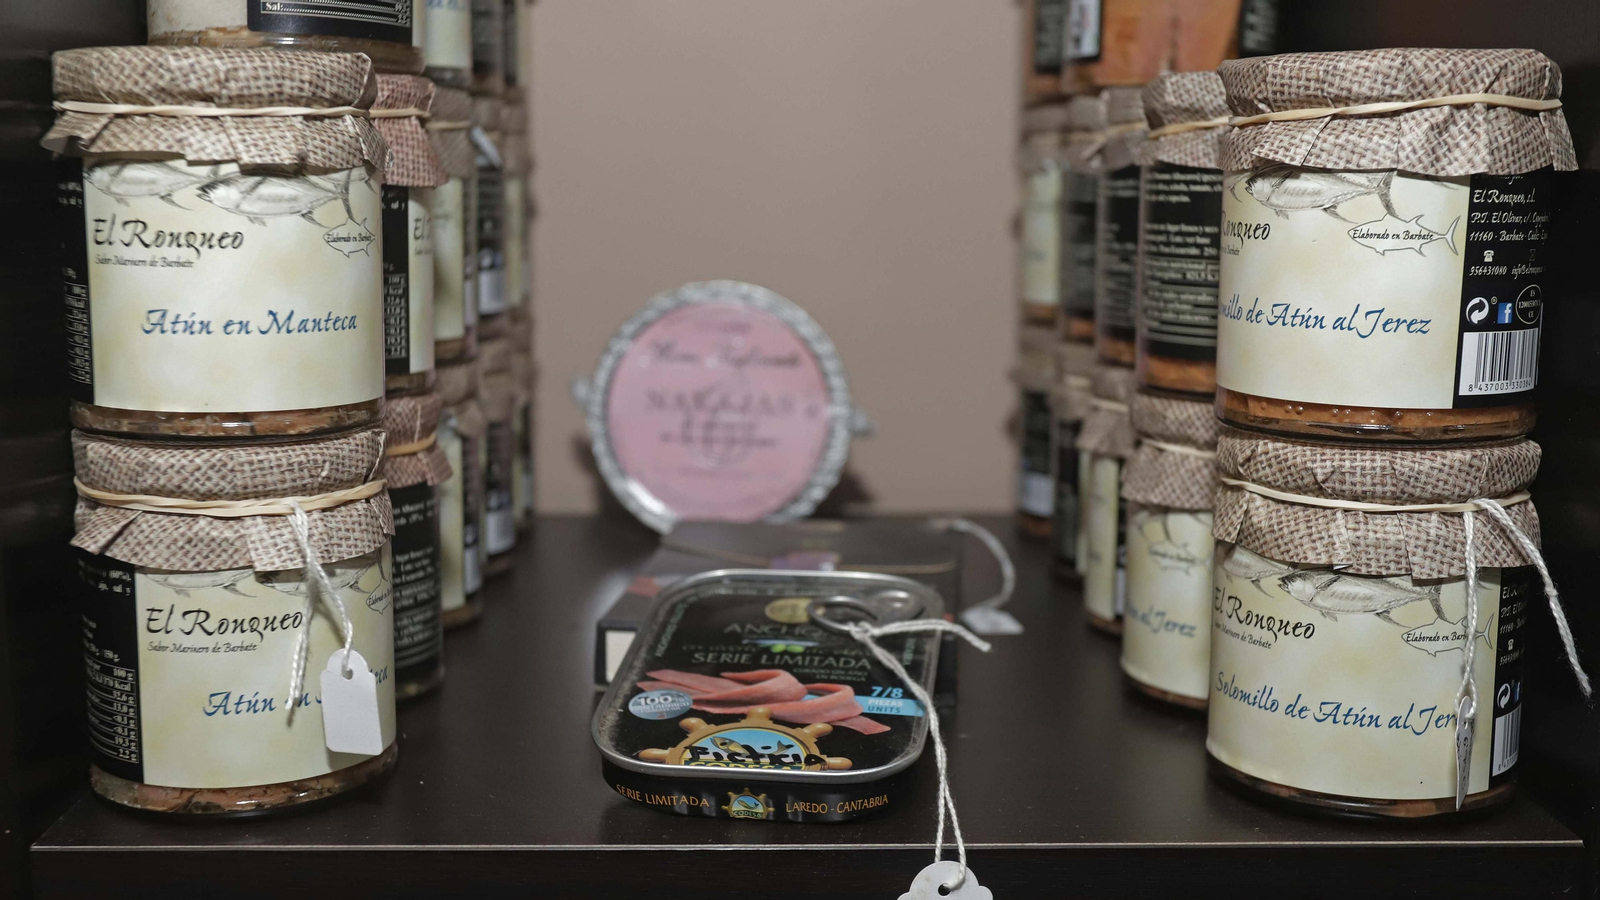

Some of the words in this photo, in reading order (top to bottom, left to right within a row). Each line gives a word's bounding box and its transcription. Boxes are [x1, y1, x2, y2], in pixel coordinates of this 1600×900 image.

[1473, 188, 1487, 203] El
[1491, 211, 1502, 223] El
[93, 213, 117, 246] El
[120, 219, 245, 259] Ronqueo
[1352, 229, 1389, 240] Elaborado
[1403, 230, 1434, 241] Barbate
[1470, 231, 1494, 241] 11160
[1499, 229, 1524, 241] Barbate
[141, 309, 214, 335] Atún
[222, 319, 252, 336] en
[258, 309, 358, 336] Manteca
[1246, 297, 1265, 323] de
[1266, 303, 1327, 329] Atún
[1332, 304, 1359, 332] al
[1355, 308, 1432, 338] Jerez
[1468, 384, 1473, 392] 8
[1478, 382, 1509, 392] 437003
[1214, 586, 1225, 614] El
[1226, 595, 1316, 643] Ronqueo
[146, 604, 175, 634] El
[179, 608, 303, 643] Ronqueo
[1240, 632, 1247, 642] de
[1247, 634, 1272, 649] Barbate
[1406, 632, 1440, 643] Elaborado
[148, 641, 169, 652] Sabor
[170, 643, 209, 654] Marinero
[210, 642, 222, 653] de
[223, 641, 258, 653] Barbate
[691, 652, 752, 665] SERIE
[760, 654, 872, 670] LIMITADA
[871, 685, 904, 699] 7/8
[203, 691, 276, 717] Atún
[285, 692, 311, 708] n
[867, 705, 902, 713] UNITS
[868, 698, 904, 707] PIEZAS
[1215, 671, 1279, 713] Solomillo
[1284, 694, 1311, 719] de
[1313, 701, 1382, 728] Atún
[1387, 703, 1414, 730] al
[1410, 705, 1455, 736] Jer
[616, 784, 642, 801] SERIE
[645, 793, 710, 808] LIMITADA
[786, 801, 828, 814] LAREDO
[836, 795, 889, 814] CANTABRIA
